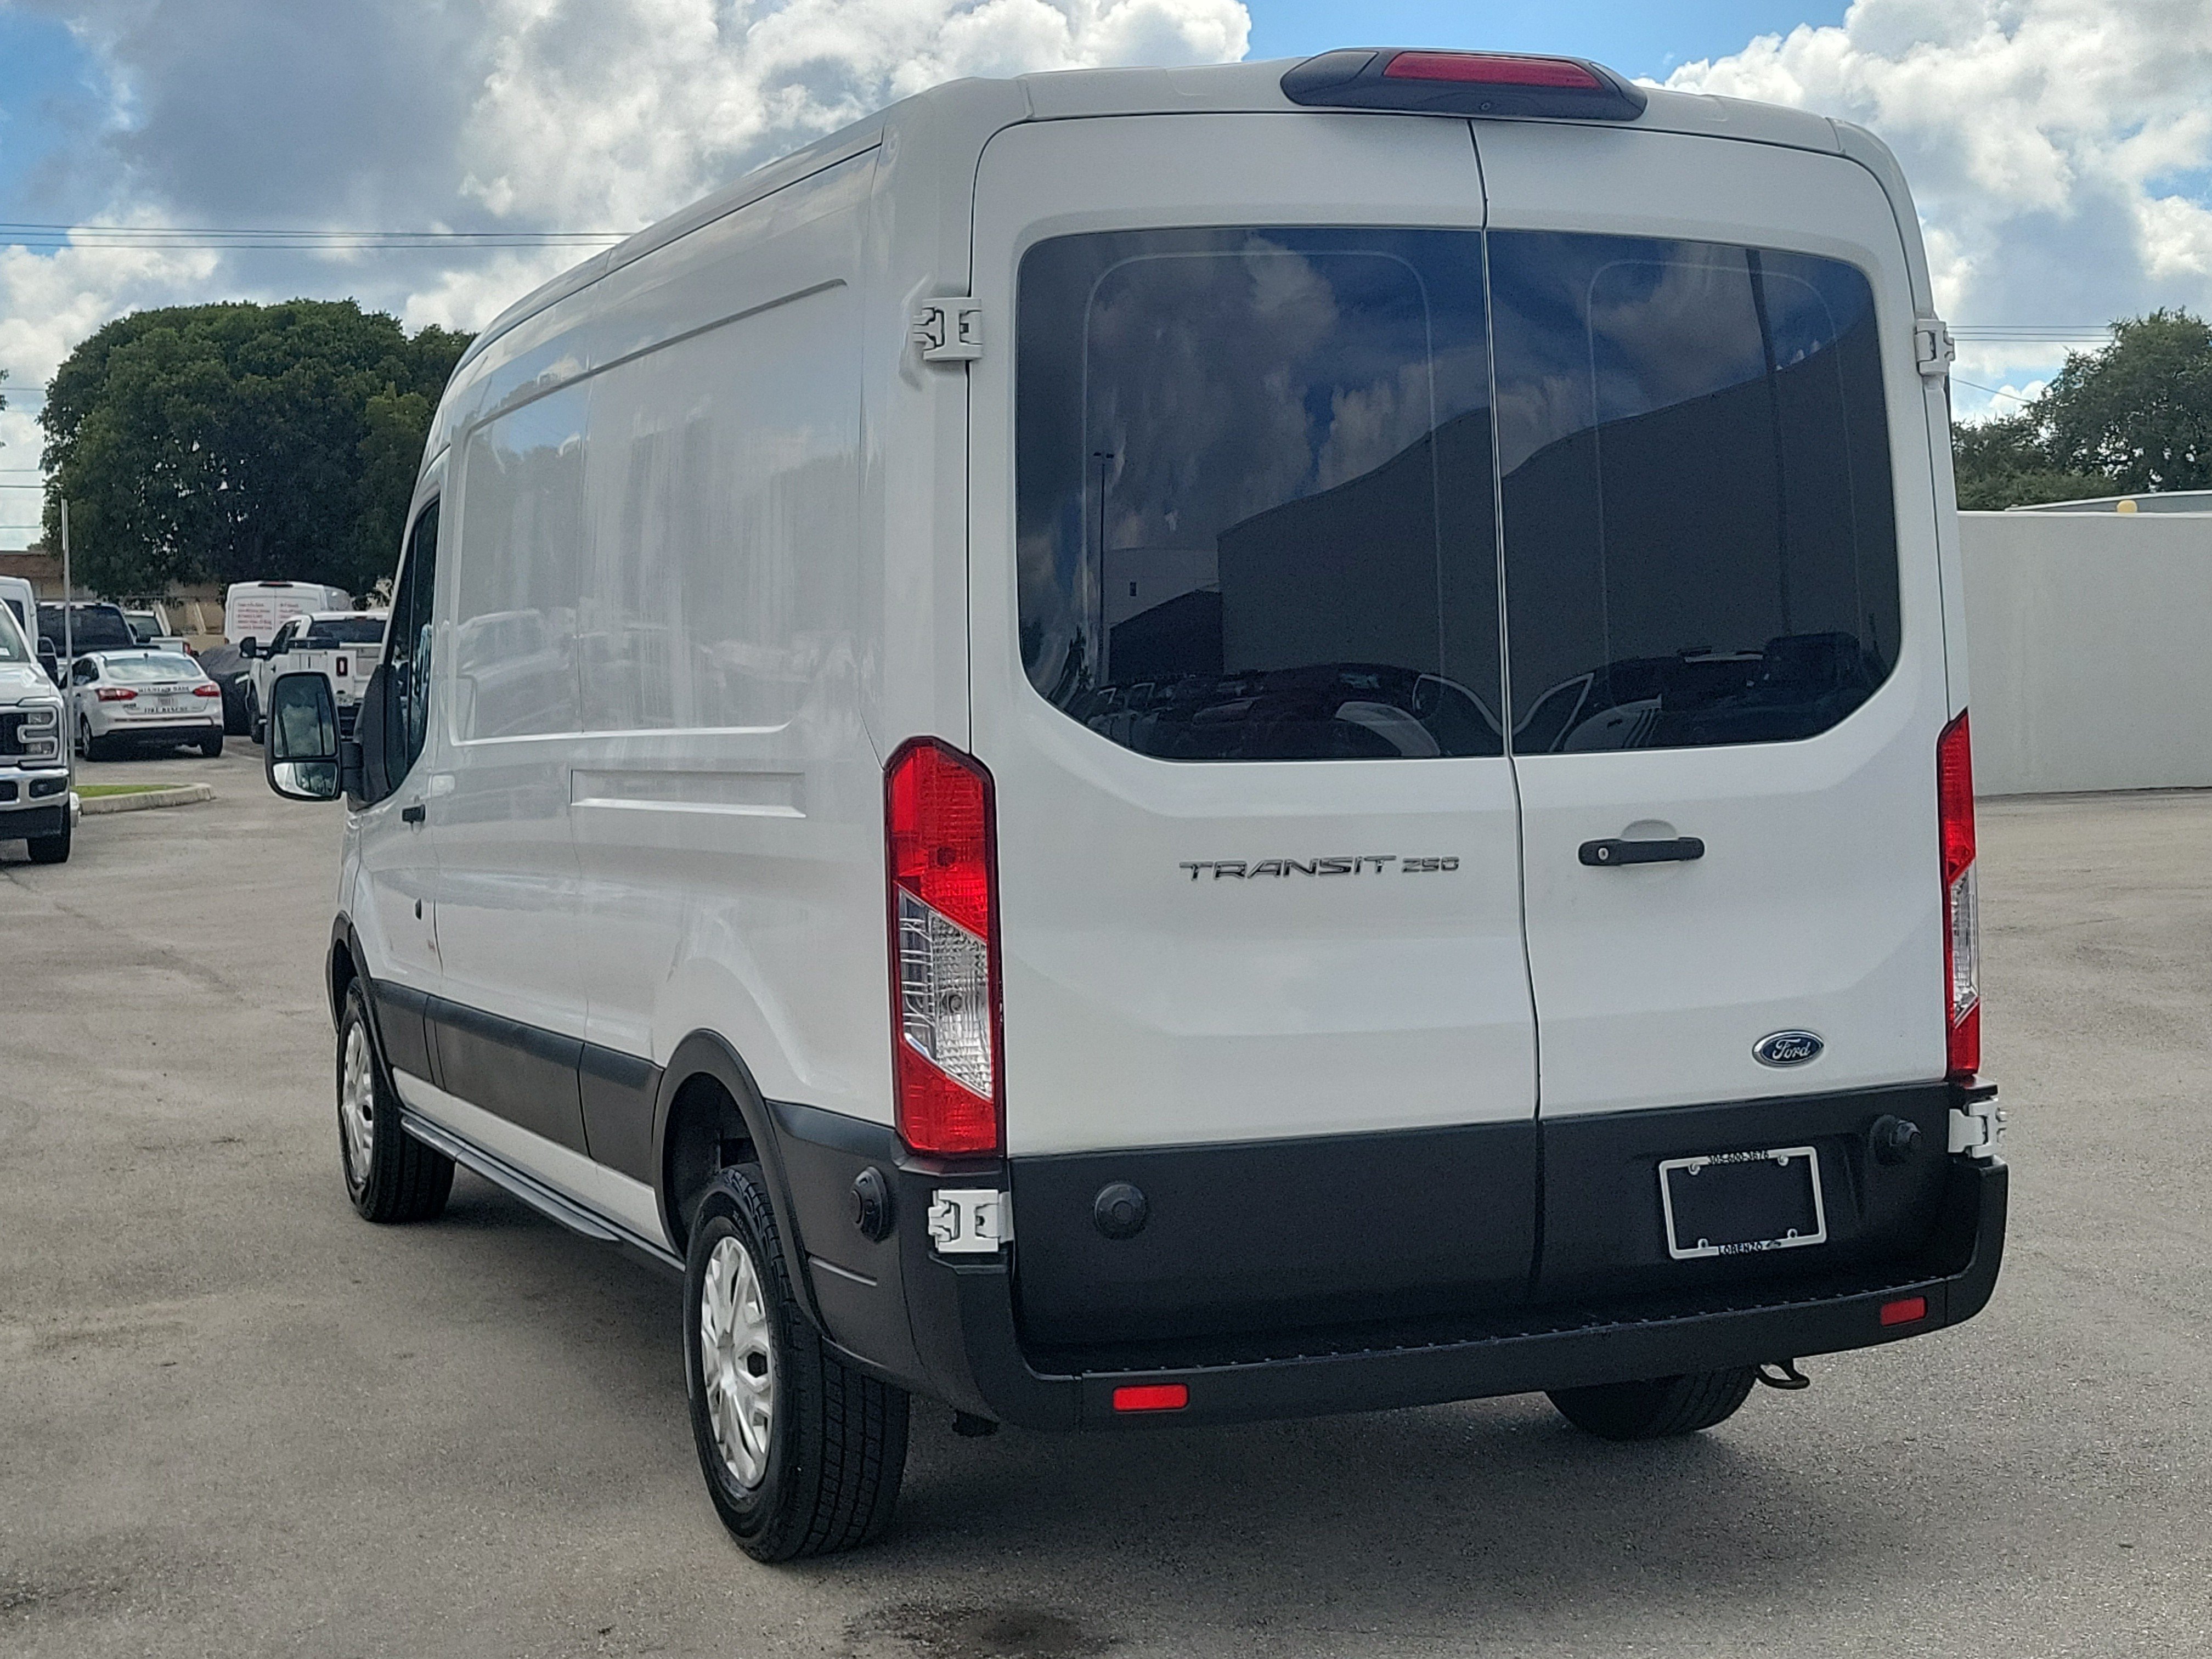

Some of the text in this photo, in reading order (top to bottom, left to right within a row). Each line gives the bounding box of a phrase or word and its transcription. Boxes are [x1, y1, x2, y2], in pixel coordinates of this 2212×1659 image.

[1179, 856, 1459, 881] TRANSIT 250
[1772, 1038, 1811, 1060] Ford
[1718, 1240, 1763, 1255] LORENZO
